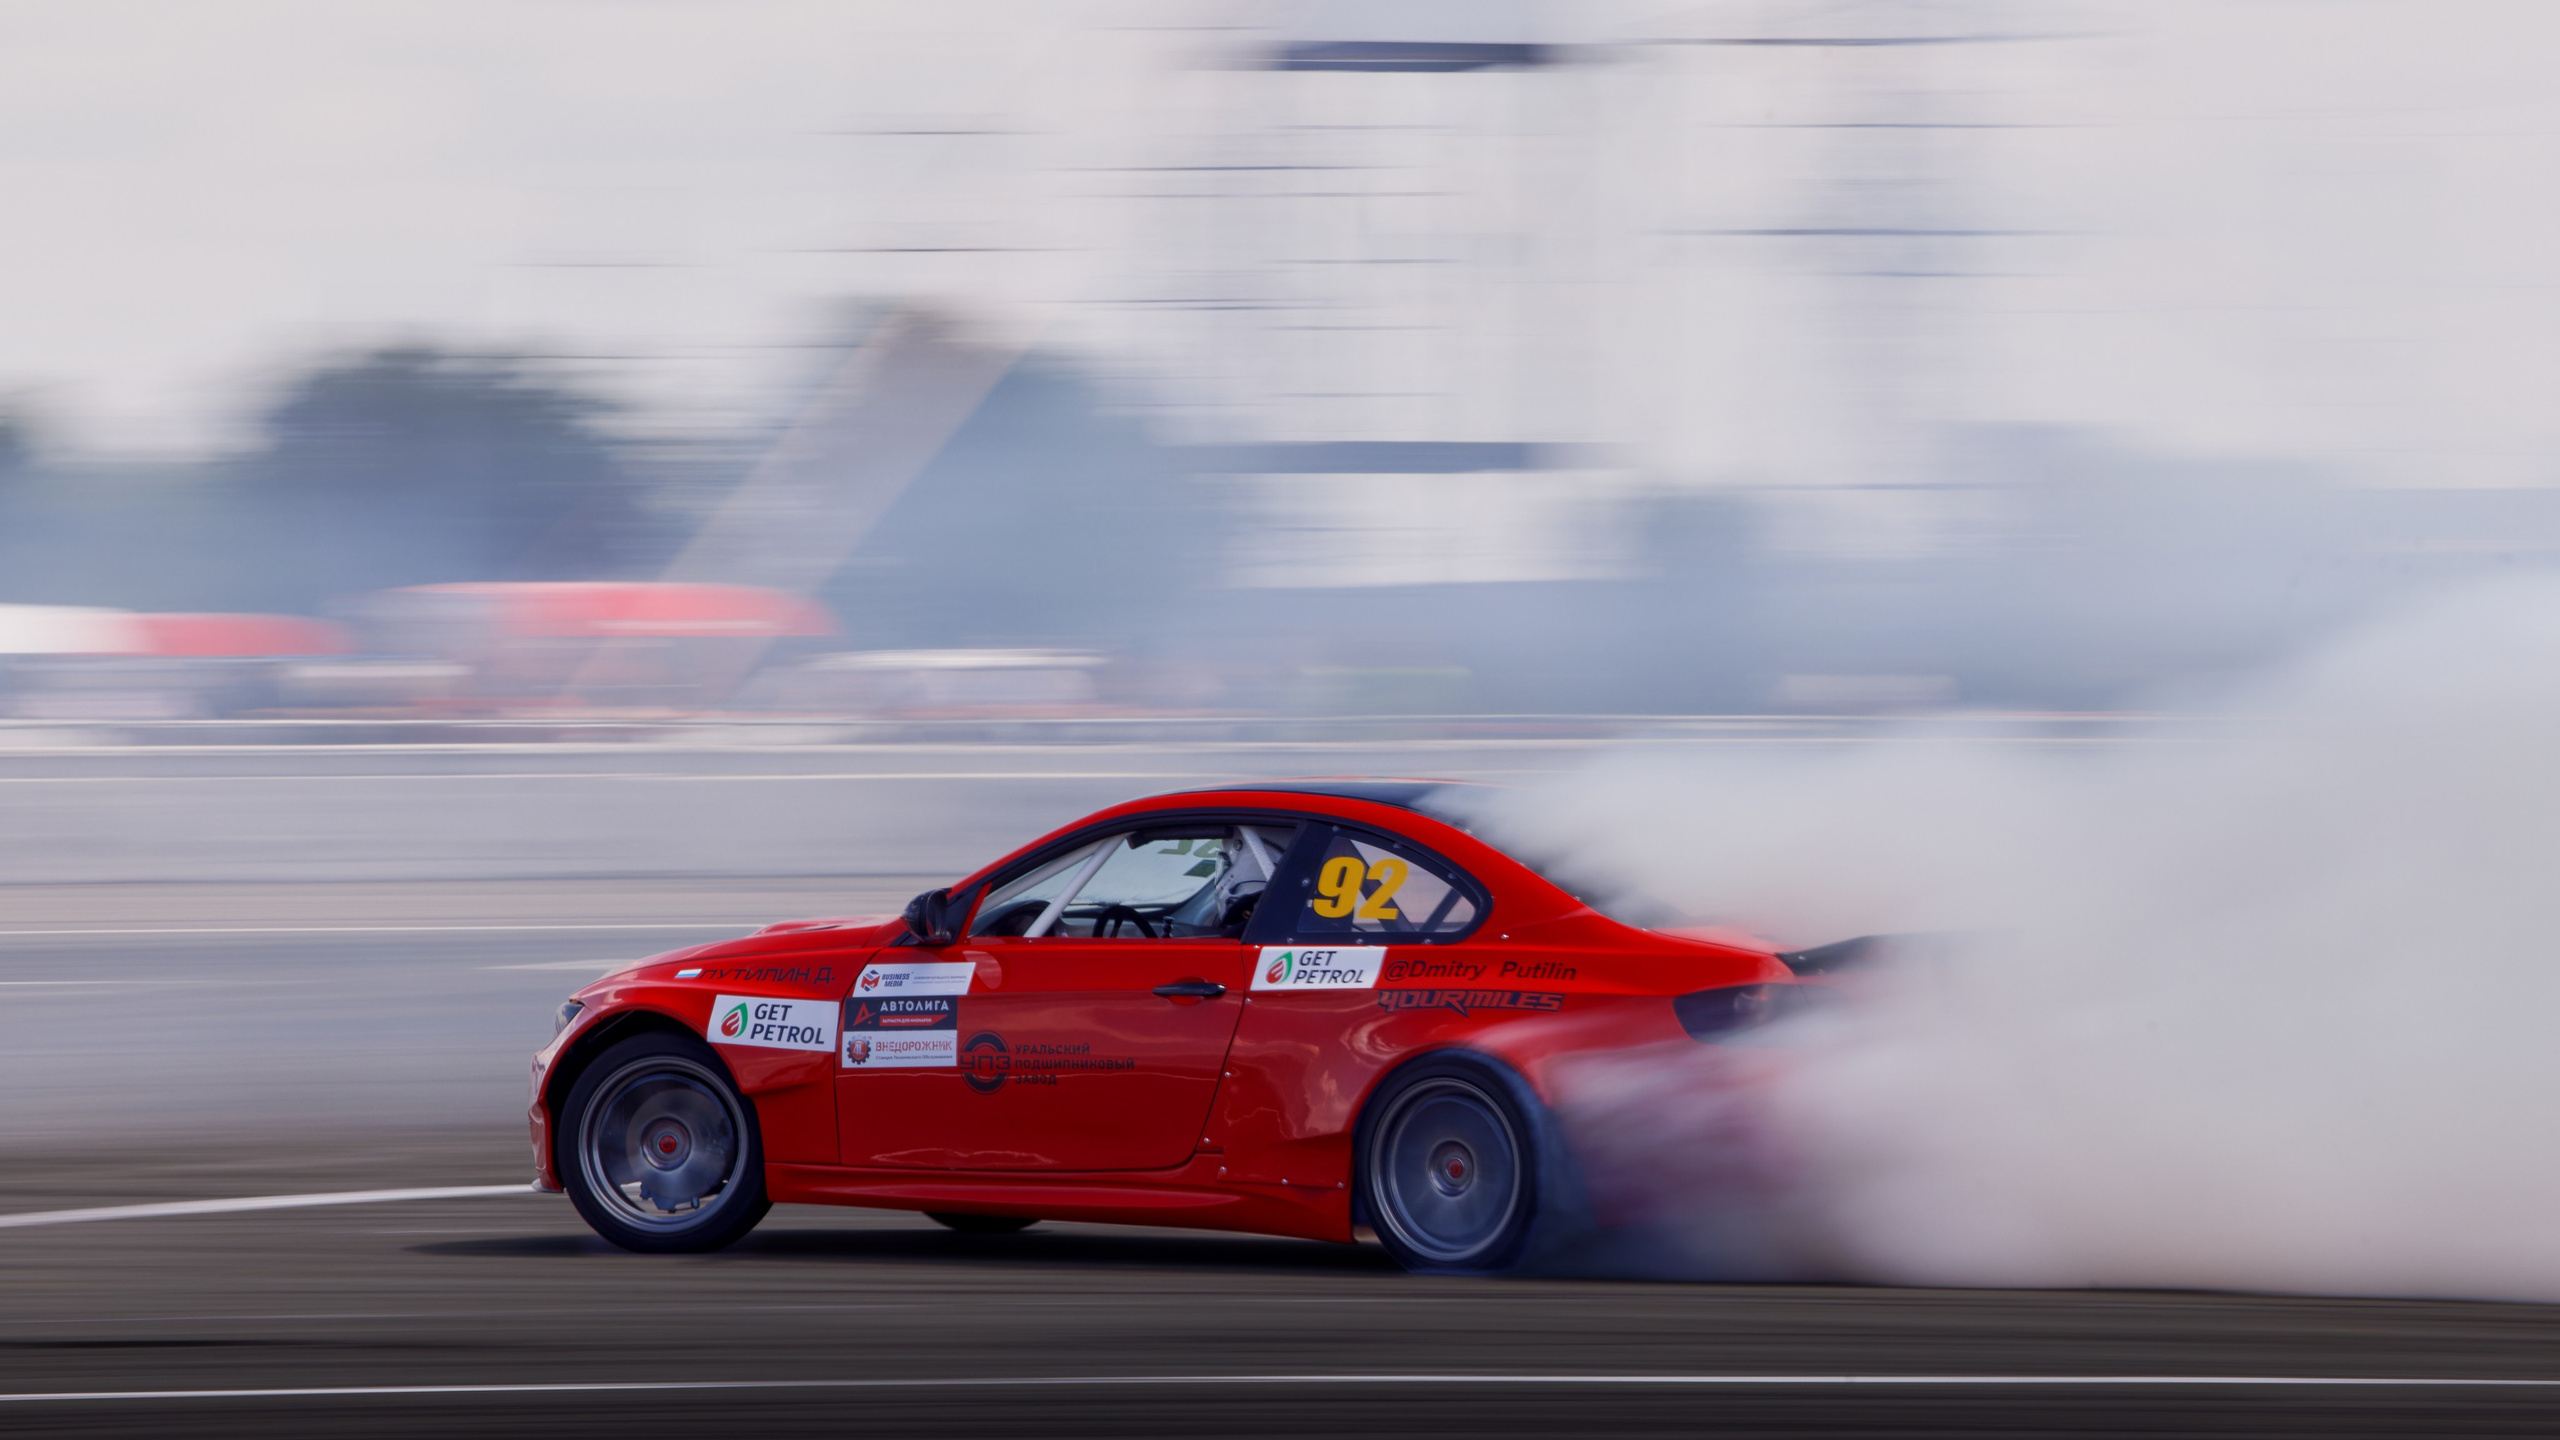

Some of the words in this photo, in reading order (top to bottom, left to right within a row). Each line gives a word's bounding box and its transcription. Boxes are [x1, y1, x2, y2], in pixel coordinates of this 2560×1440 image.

[1313, 856, 1408, 920] 92
[1299, 951, 1337, 966] GET
[813, 967, 835, 984] Д.
[1293, 969, 1364, 984] PETROL
[1385, 960, 1486, 981] @Dmitry
[1499, 961, 1577, 980] Putilin
[754, 1003, 792, 1021] GET
[880, 1000, 949, 1011] АВТОЛИГА
[750, 1023, 824, 1044] PETROL
[875, 1041, 952, 1053] ВНЕДОРОЖНИК
[1015, 1043, 1090, 1055] УРАЛЬСКИЙ
[1015, 1057, 1135, 1070] ПОДШИПНИКОВЫЙ
[1015, 1074, 1057, 1085] ЗАВОД
